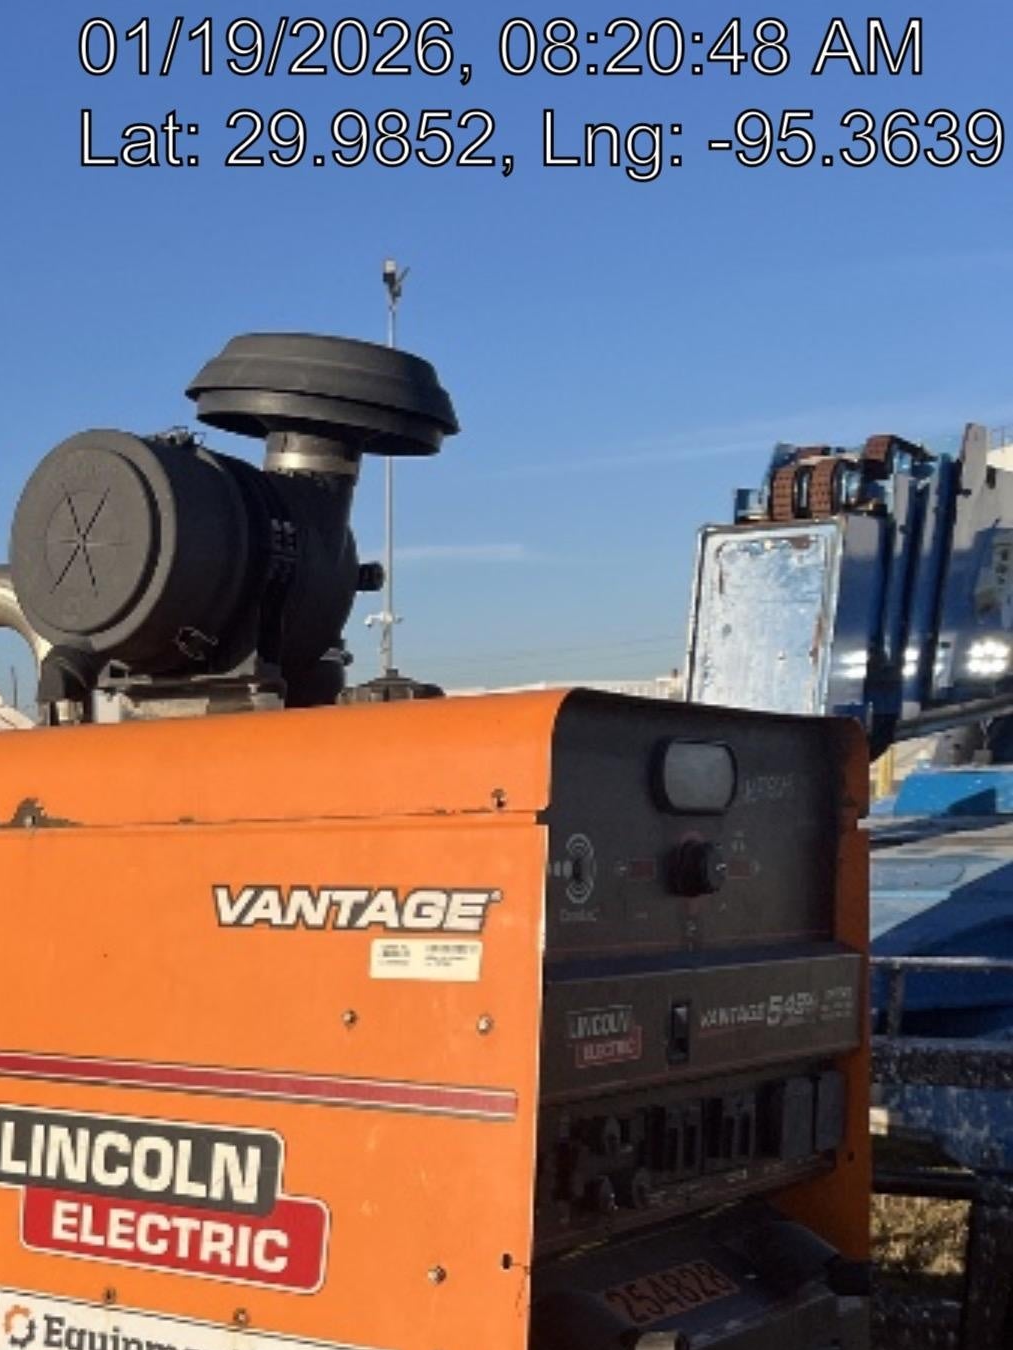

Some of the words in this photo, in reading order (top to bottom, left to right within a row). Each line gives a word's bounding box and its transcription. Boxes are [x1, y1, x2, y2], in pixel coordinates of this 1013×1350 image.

[212, 885, 492, 932] VANTAGE
[0, 1121, 262, 1204] LINCOLN
[51, 1200, 289, 1273] ELECTRIC
